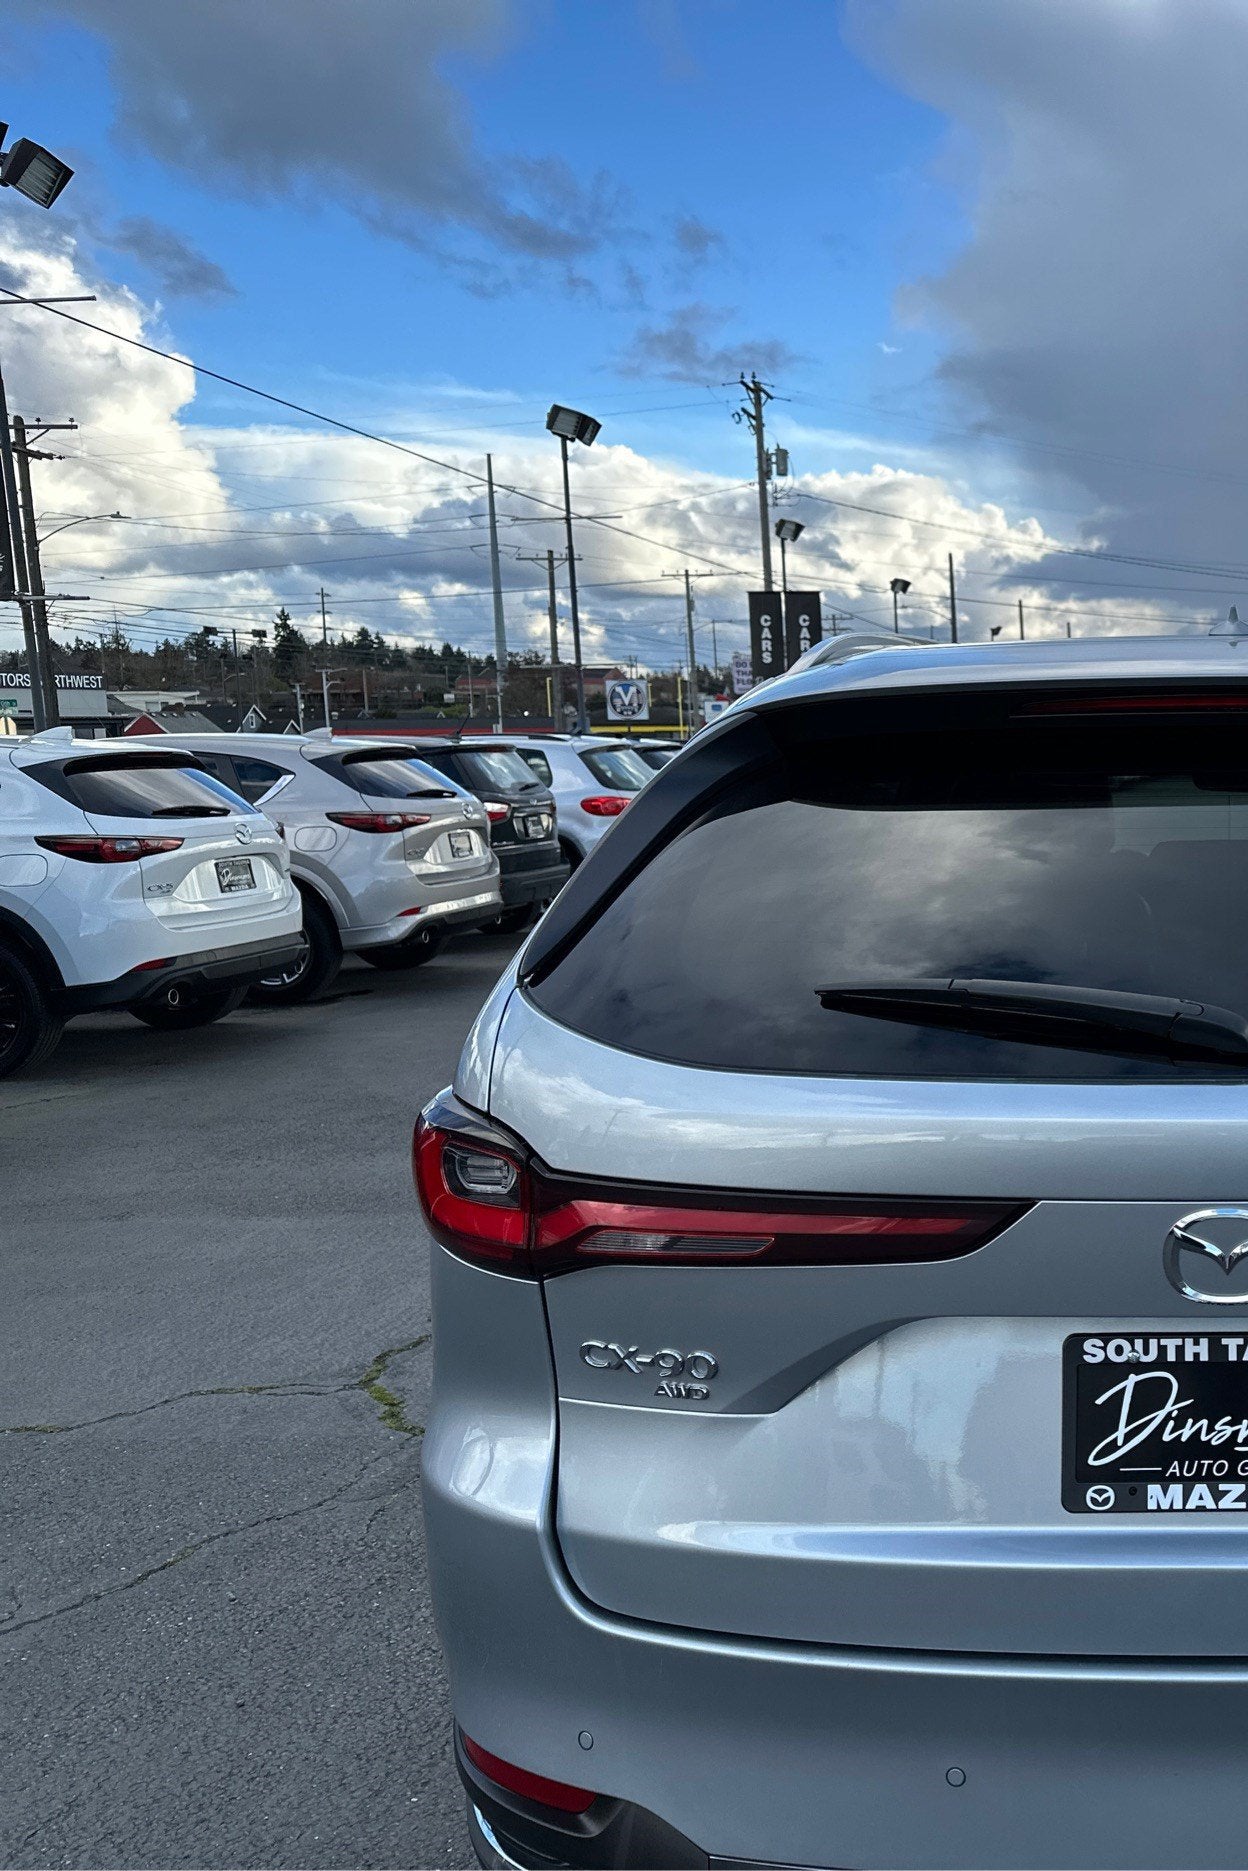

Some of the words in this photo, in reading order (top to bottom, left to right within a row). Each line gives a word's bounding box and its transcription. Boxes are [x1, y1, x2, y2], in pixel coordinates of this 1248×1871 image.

[760, 614, 773, 664] CARS
[798, 614, 812, 657] CAR
[40, 674, 103, 689] RTHWEST
[579, 1340, 719, 1380] CX-90
[1082, 1337, 1209, 1364] SOUTH
[654, 1380, 710, 1400] AWD
[1166, 1459, 1229, 1477] AUTO
